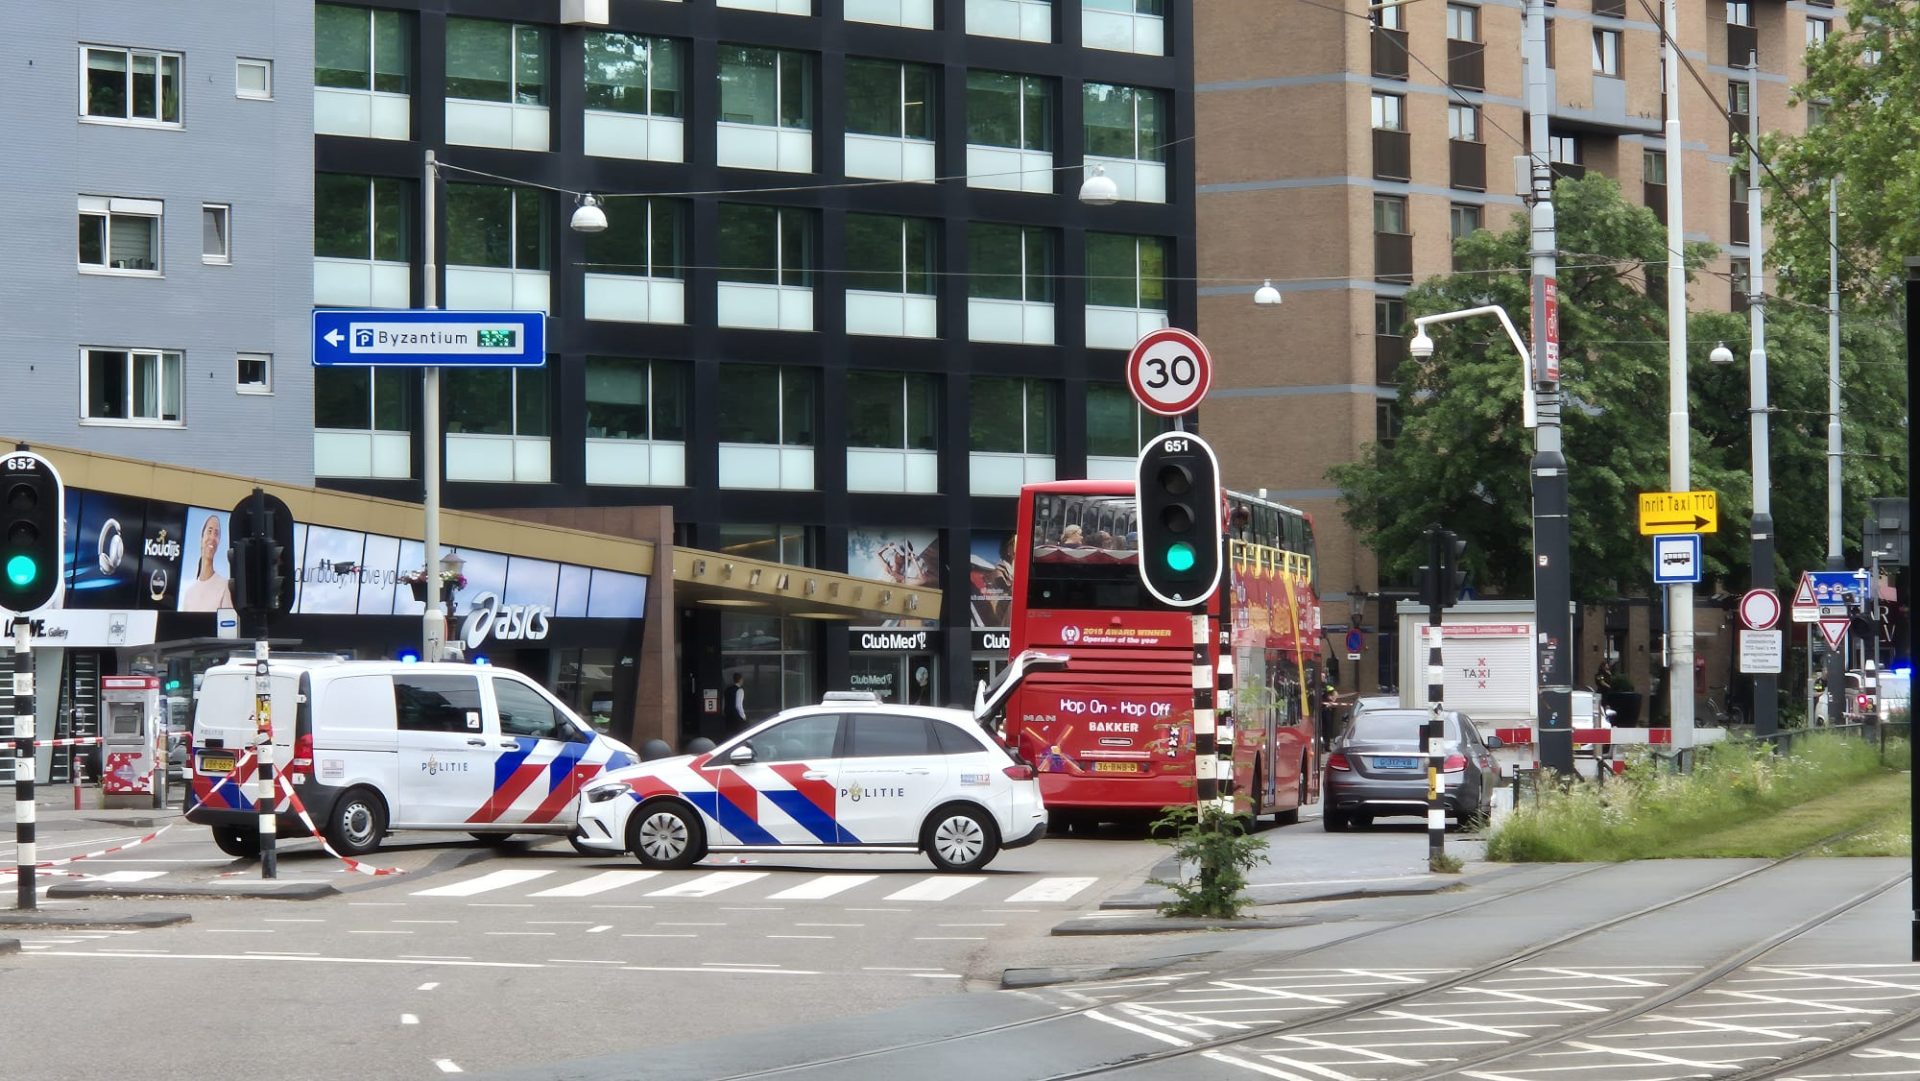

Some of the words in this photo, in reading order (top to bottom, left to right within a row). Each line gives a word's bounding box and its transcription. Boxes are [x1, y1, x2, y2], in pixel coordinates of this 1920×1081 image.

[378, 331, 468, 346] Byzantium
[1146, 355, 1195, 388] 30
[1164, 440, 1189, 452] 651
[7, 458, 36, 470] 652
[1667, 495, 1691, 511] Taxi
[1694, 494, 1715, 511] TTO
[144, 538, 180, 561] Koudijs
[1105, 628, 1136, 636] AWARD
[1137, 628, 1171, 637] WINNER
[983, 633, 1010, 649] Club
[1083, 635, 1116, 644] Operator
[1117, 636, 1126, 644] of
[1127, 636, 1140, 644] the
[1463, 668, 1491, 678] TAXI
[1060, 699, 1086, 714] Hop
[1090, 700, 1107, 714] On
[1120, 701, 1146, 717] Hop
[1150, 702, 1171, 717] Off
[1023, 714, 1057, 722] MAN
[1088, 721, 1139, 733] BAKKER
[421, 762, 468, 775] POLITIE
[841, 786, 904, 802] POLITIE
